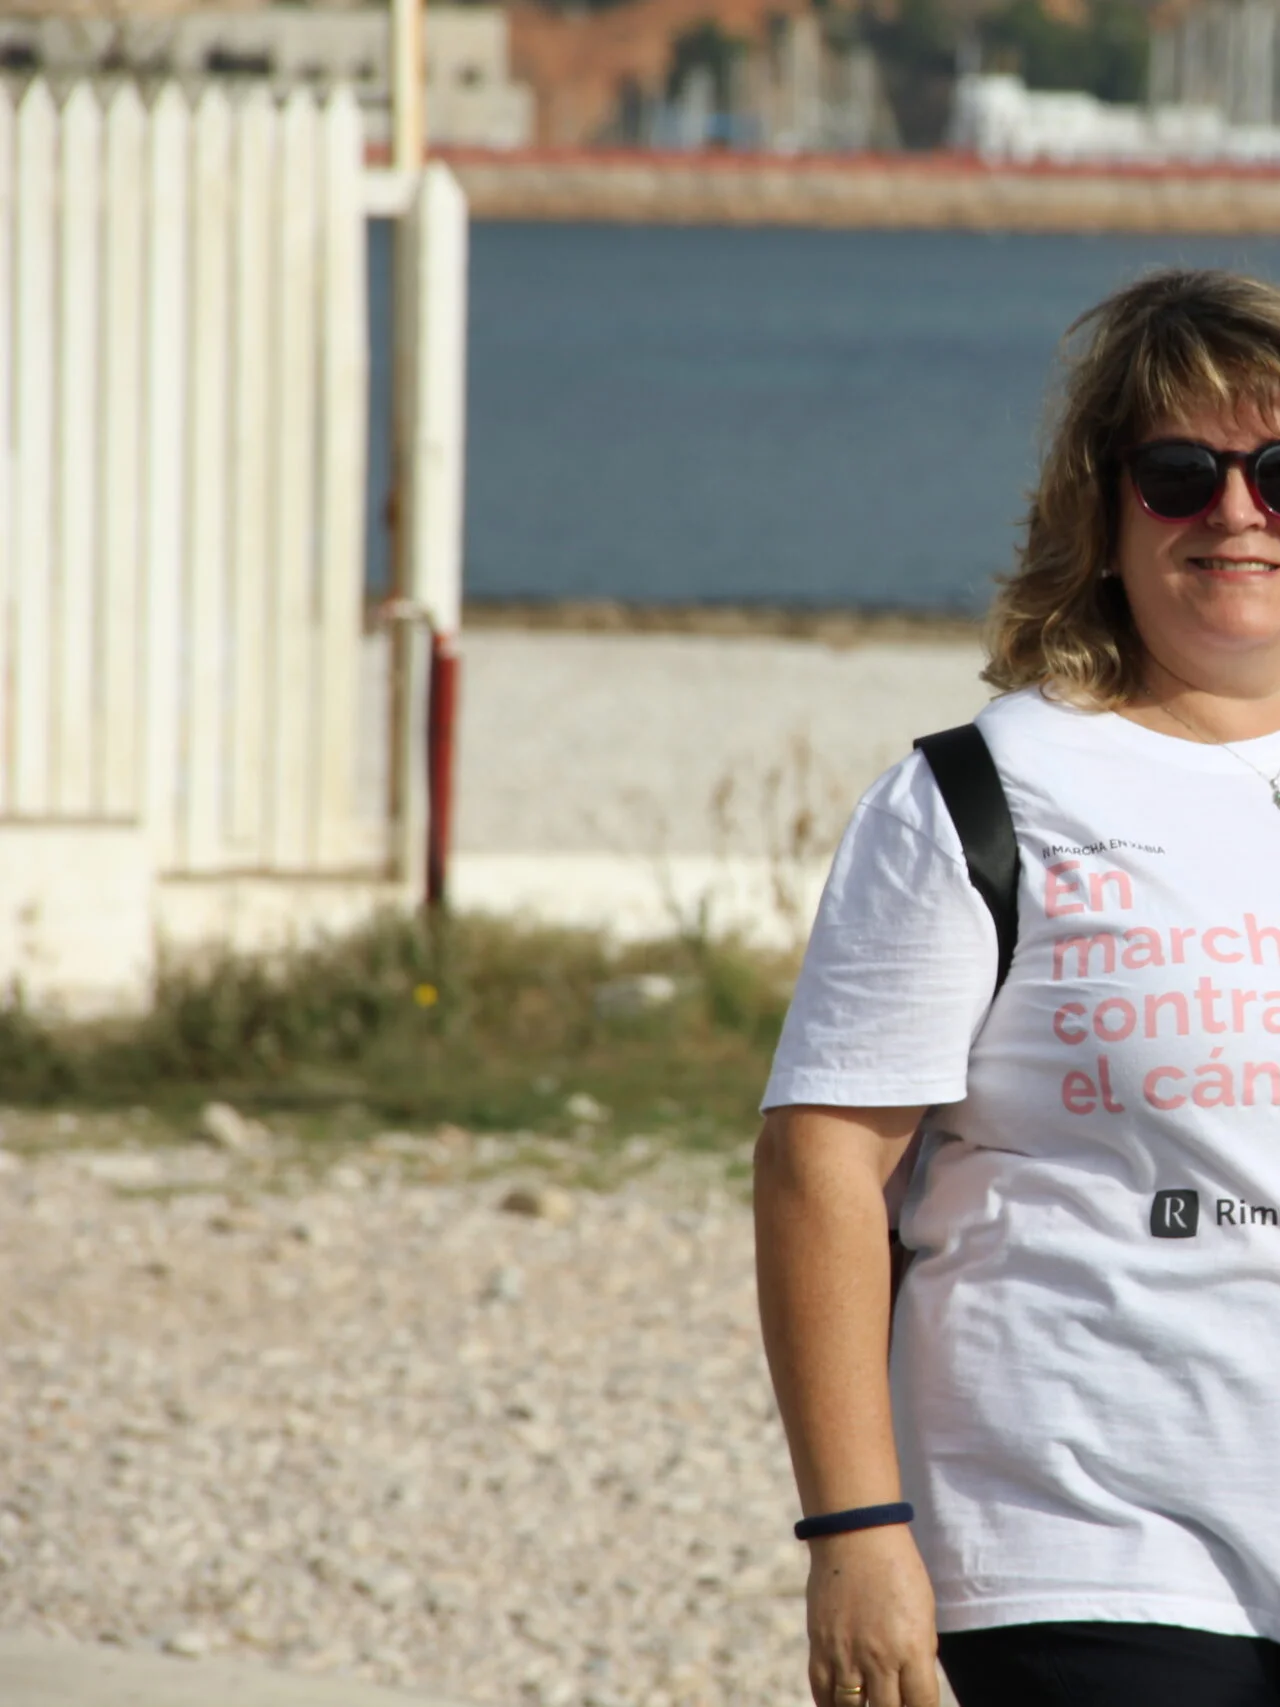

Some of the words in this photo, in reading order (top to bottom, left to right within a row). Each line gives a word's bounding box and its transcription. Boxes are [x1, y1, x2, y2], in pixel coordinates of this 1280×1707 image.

[1052, 841, 1107, 856] MARCHA
[1109, 838, 1128, 849] EN
[1044, 860, 1133, 919] En
[1062, 1055, 1125, 1115] el
[1164, 1197, 1188, 1229] R
